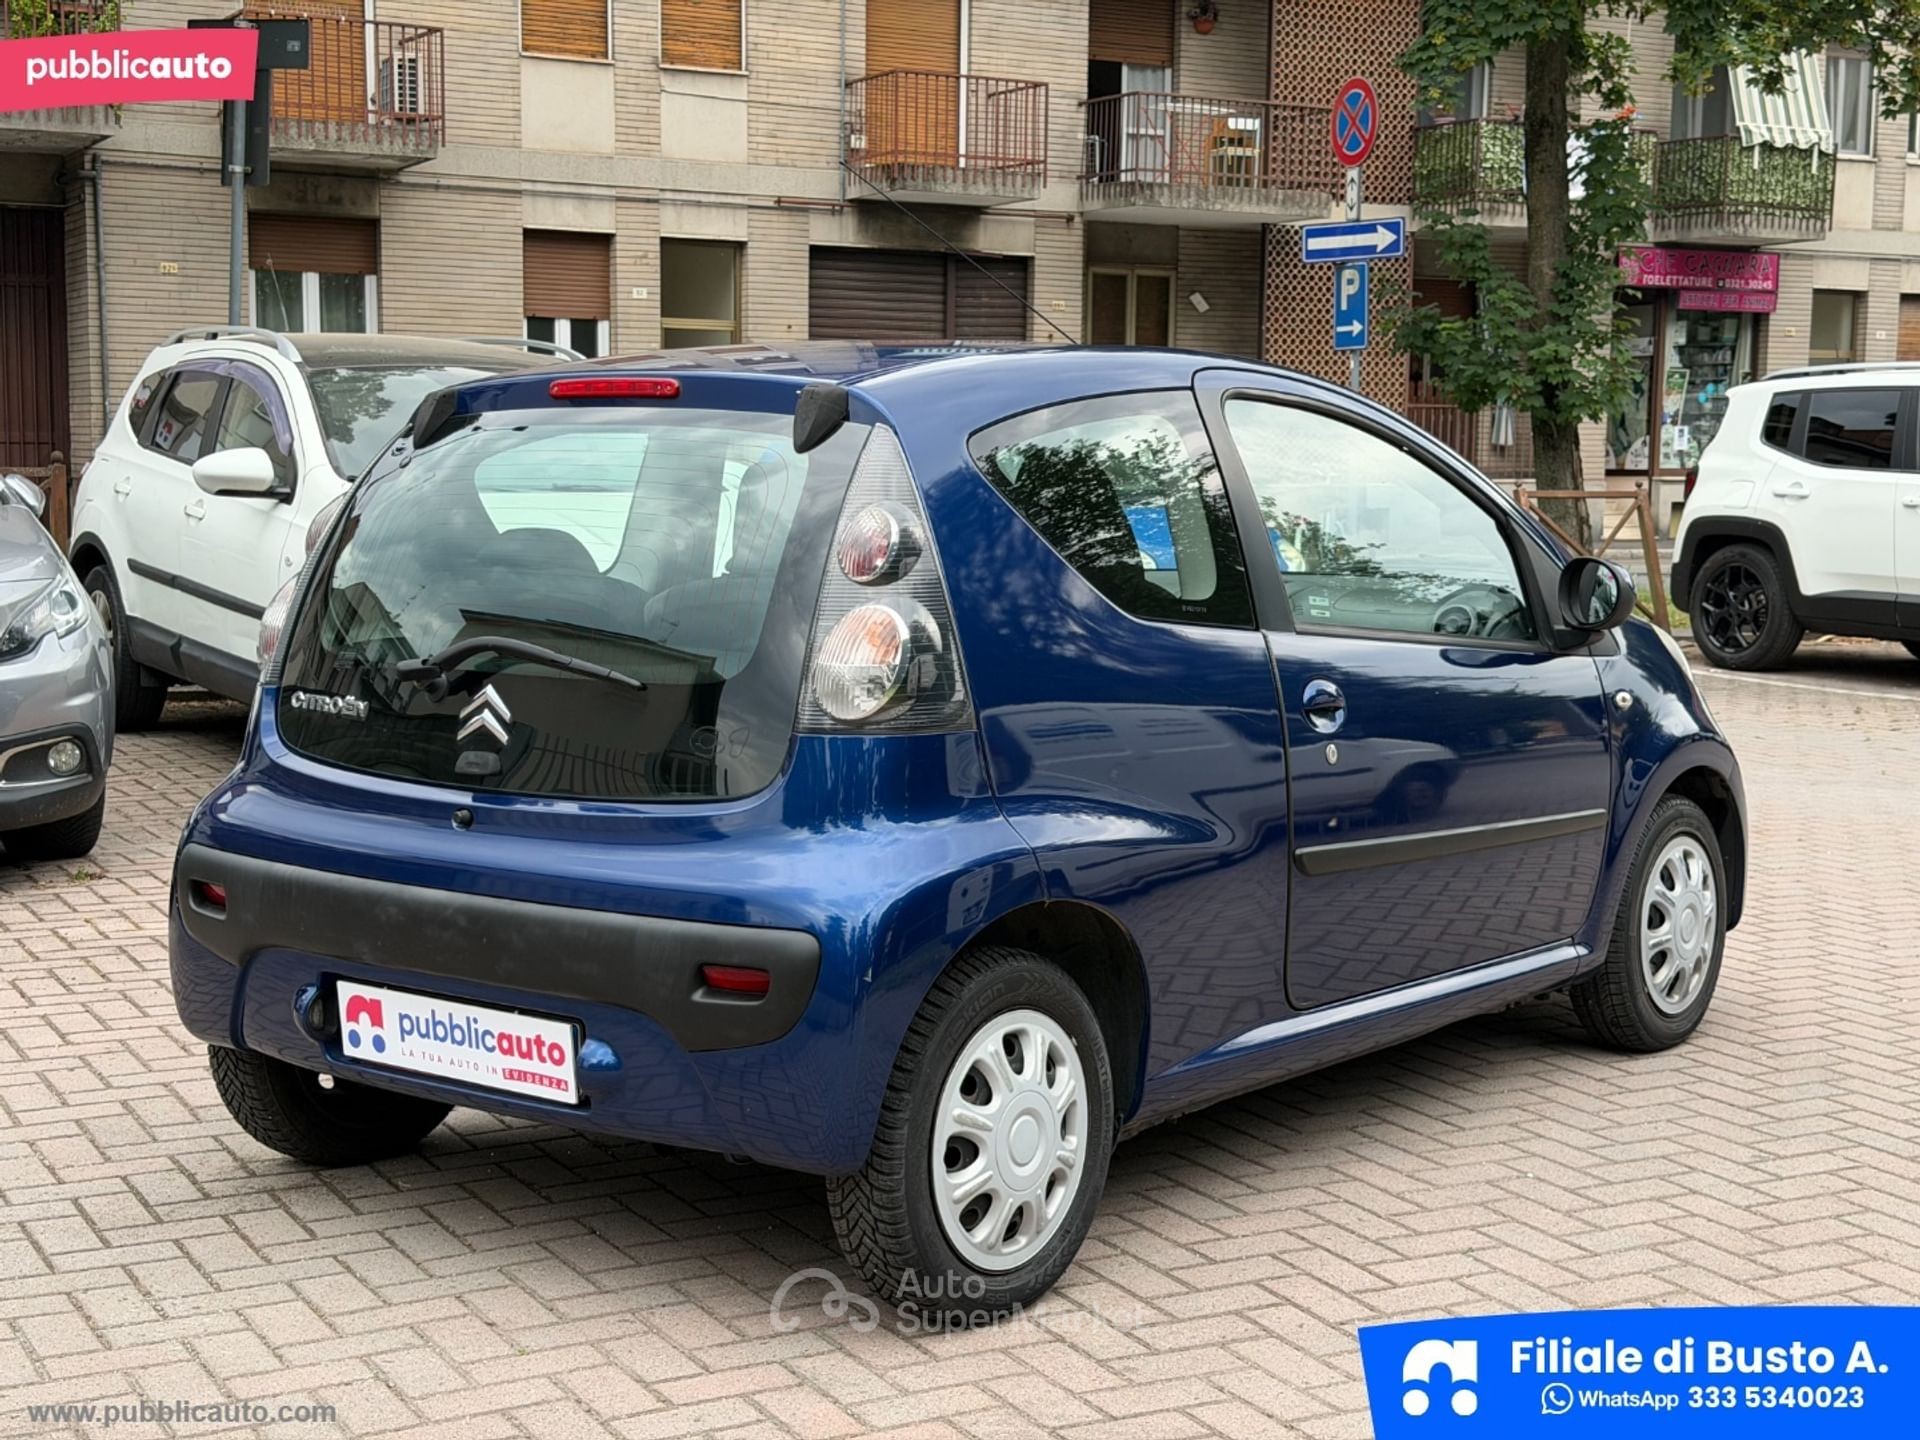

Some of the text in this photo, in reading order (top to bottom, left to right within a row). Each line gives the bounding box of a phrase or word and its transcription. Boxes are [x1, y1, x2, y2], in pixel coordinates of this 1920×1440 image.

[1341, 269, 1360, 311] P
[1642, 275, 1713, 288] TOELETTATURE
[291, 690, 369, 718] CITROËN
[398, 1009, 567, 1067] pubblicauto
[401, 1047, 568, 1091] LA TUA AUTO IN EVIDENZA
